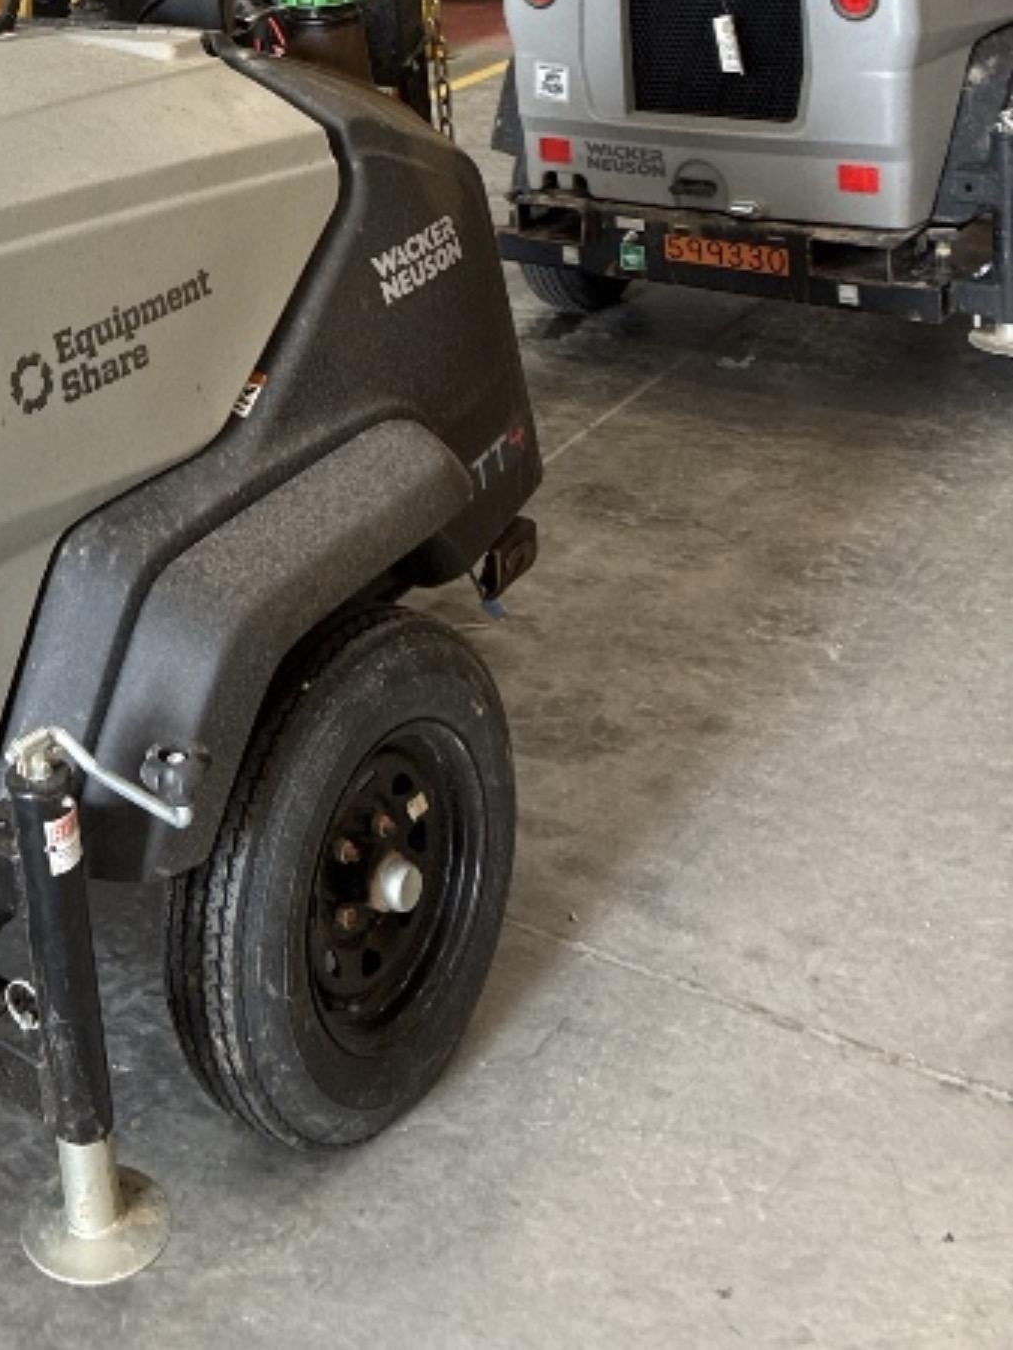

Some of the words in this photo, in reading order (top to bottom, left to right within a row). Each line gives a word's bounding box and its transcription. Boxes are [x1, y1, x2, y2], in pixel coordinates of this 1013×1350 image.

[584, 140, 663, 163] WACKER
[587, 156, 666, 178] NEUSON
[370, 215, 456, 279] WACKER
[379, 236, 462, 306] NEUSON
[667, 236, 786, 274] 599330
[52, 268, 213, 364] Equipment
[61, 344, 150, 403] Share
